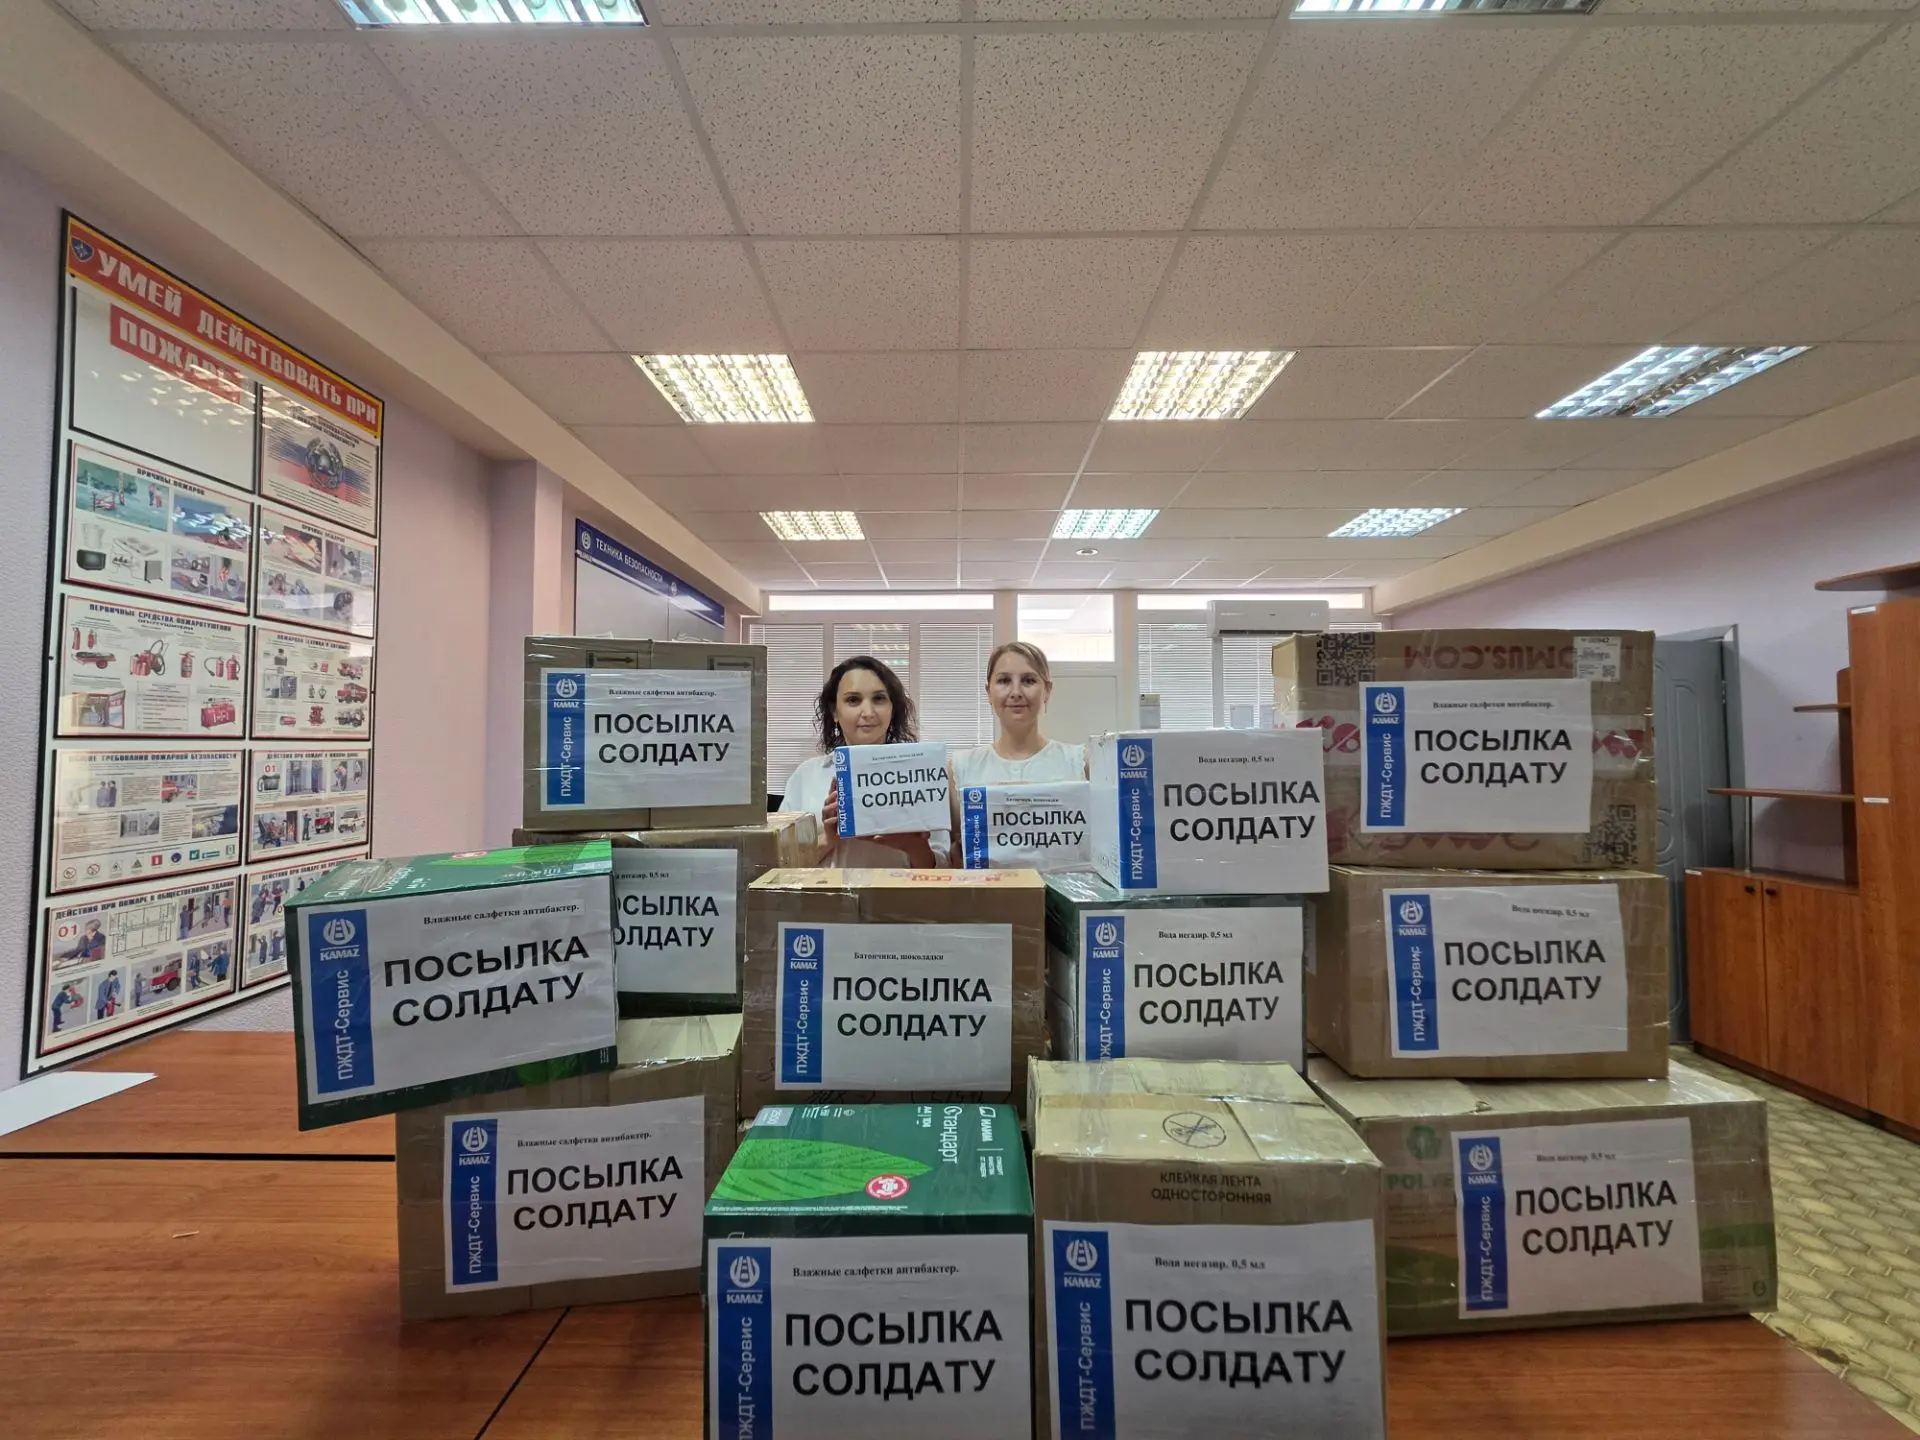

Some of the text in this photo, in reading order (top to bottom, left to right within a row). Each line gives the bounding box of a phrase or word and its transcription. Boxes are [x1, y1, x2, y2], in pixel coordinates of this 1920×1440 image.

[98, 248, 376, 425] УМЕЙ ДЕЙСТВОВАТЬ ПРИ
[596, 538, 623, 563] ТЕХНИКА
[624, 554, 664, 583] БЕЗОПАСНОСТИ
[138, 611, 174, 623] СРЕДСТВА
[1468, 701, 1505, 710] салфетки
[594, 713, 735, 734] ПОСЫЛКА
[1372, 716, 1399, 725] KAMAZ
[1414, 729, 1572, 752] ПОСЫЛКА
[560, 716, 574, 797] ПЖДТ-Сервис
[599, 743, 730, 766] СОЛДАТУ
[264, 765, 276, 774] 01
[857, 767, 948, 787] ПОСЫЛКА
[1120, 771, 1148, 779] KAMAZ
[1380, 732, 1394, 819] ПЖДТ-Сервис
[1420, 762, 1568, 788] СОЛДАТУ
[862, 787, 947, 807] СОЛДАТУ
[1164, 780, 1320, 807] ПОСЫЛКА
[992, 810, 1086, 826] ПОСЫЛКА
[1170, 815, 1316, 845] СОЛДАТУ
[997, 831, 1083, 848] СОЛДАТУ
[1130, 788, 1144, 880] ПЖДТ-Сервис
[56, 904, 98, 921] ДЕЙСТВИЯ
[101, 900, 116, 912] ПРИ
[423, 903, 580, 926] Влажные салфетки антибактер.
[617, 895, 720, 917] СЫЛКА
[57, 924, 78, 939] 01
[613, 925, 714, 950] ОЛДАТУ
[1399, 928, 1427, 936] KAMAZ
[320, 947, 360, 962] KAMAZ
[384, 936, 589, 987] ПОСЫЛКА
[854, 952, 944, 961] Батончики, шоколадки
[1093, 949, 1120, 959] KAMAZ
[1444, 939, 1606, 966] ПОСЫЛКА
[791, 961, 817, 970] KAMAZ
[1134, 961, 1284, 988] ПОСЫЛКА
[393, 972, 584, 1027] СОЛДАТУ
[833, 977, 992, 1003] ПОСЫЛКА
[1410, 946, 1425, 1042] ПЖДТ-Сервис
[1452, 976, 1602, 1005] СОЛДАТУ
[1139, 997, 1279, 1028] СОЛДАТУ
[334, 970, 355, 1081] ПЖДТ-Сервис
[797, 979, 811, 1074] ПЖДТ-Сервис
[837, 1014, 987, 1041] СОЛДАТУ
[558, 1136, 598, 1147] салфетки
[600, 1132, 652, 1143] антибактер.
[938, 1106, 963, 1165] Стандарт
[459, 1155, 491, 1166] KAMAZ
[507, 1156, 683, 1195] ПОСЫЛКА
[1160, 1171, 1261, 1187] КЛЕЙКАЯ ЛЕНТА
[1468, 1174, 1497, 1185] KAMAZ
[1151, 1188, 1272, 1204] ОДНОСТОРОННЯЯ
[1515, 1180, 1678, 1216] ПОСЫЛКА
[514, 1193, 677, 1230] СОЛДАТУ
[468, 1175, 482, 1274] ПЖДТ-Сервис
[1480, 1195, 1493, 1301] ПЖДТ-Сервис
[1522, 1220, 1673, 1257] СОЛДАТУ
[793, 1263, 960, 1279] Влажные салфетки антибактер.
[1155, 1257, 1265, 1271] Вода негазир. 0,5 мл
[1064, 1276, 1102, 1289] KAMAZ
[726, 1294, 763, 1304] KAMAZ
[786, 1309, 1003, 1346] ПОСЫЛКА
[1125, 1299, 1352, 1334] ПОСЫЛКА
[1079, 1302, 1096, 1430] ПЖДТ-Сервис
[1134, 1349, 1346, 1389] СОЛДАТУ
[793, 1359, 996, 1401] СОЛДАТУ
